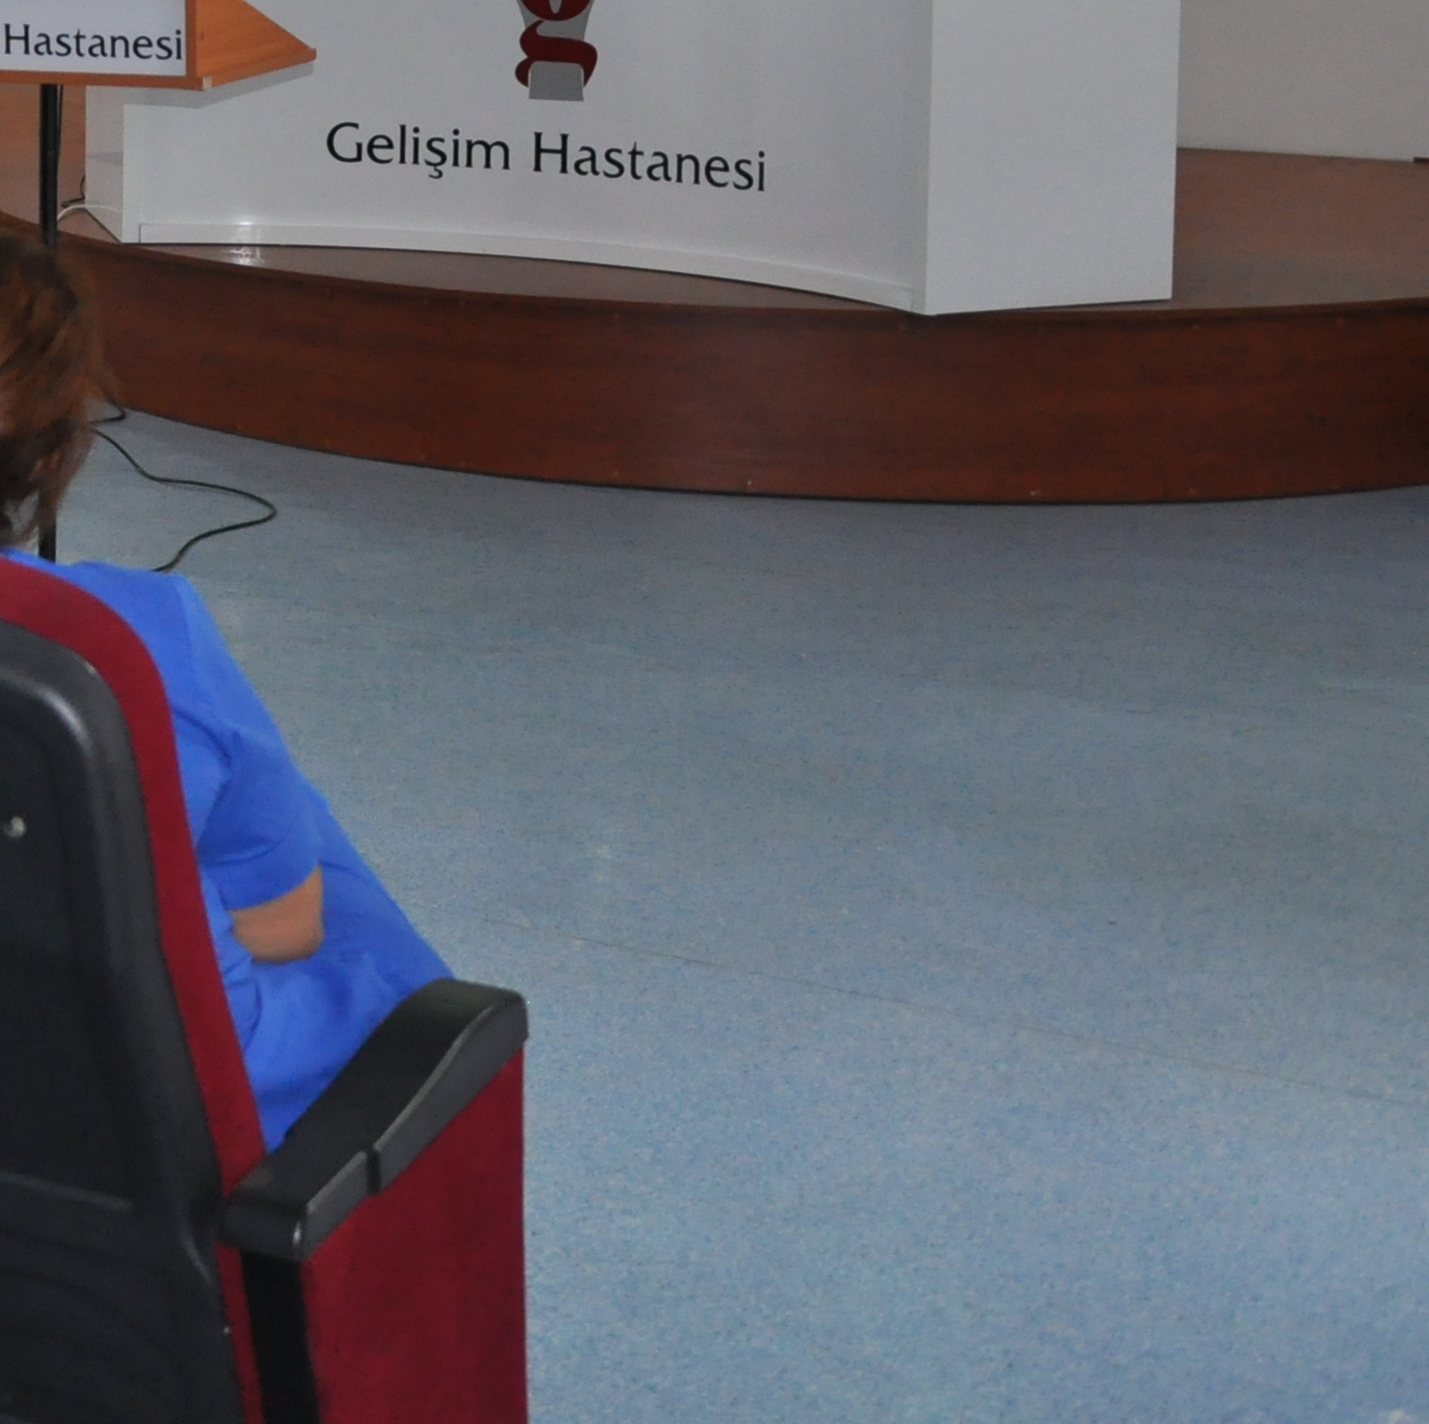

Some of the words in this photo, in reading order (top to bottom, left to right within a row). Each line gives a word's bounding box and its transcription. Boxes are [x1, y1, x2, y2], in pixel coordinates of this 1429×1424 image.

[4, 23, 183, 61] Hastanesi
[326, 121, 511, 179] Gelişim
[532, 131, 766, 193] Hastanesi
